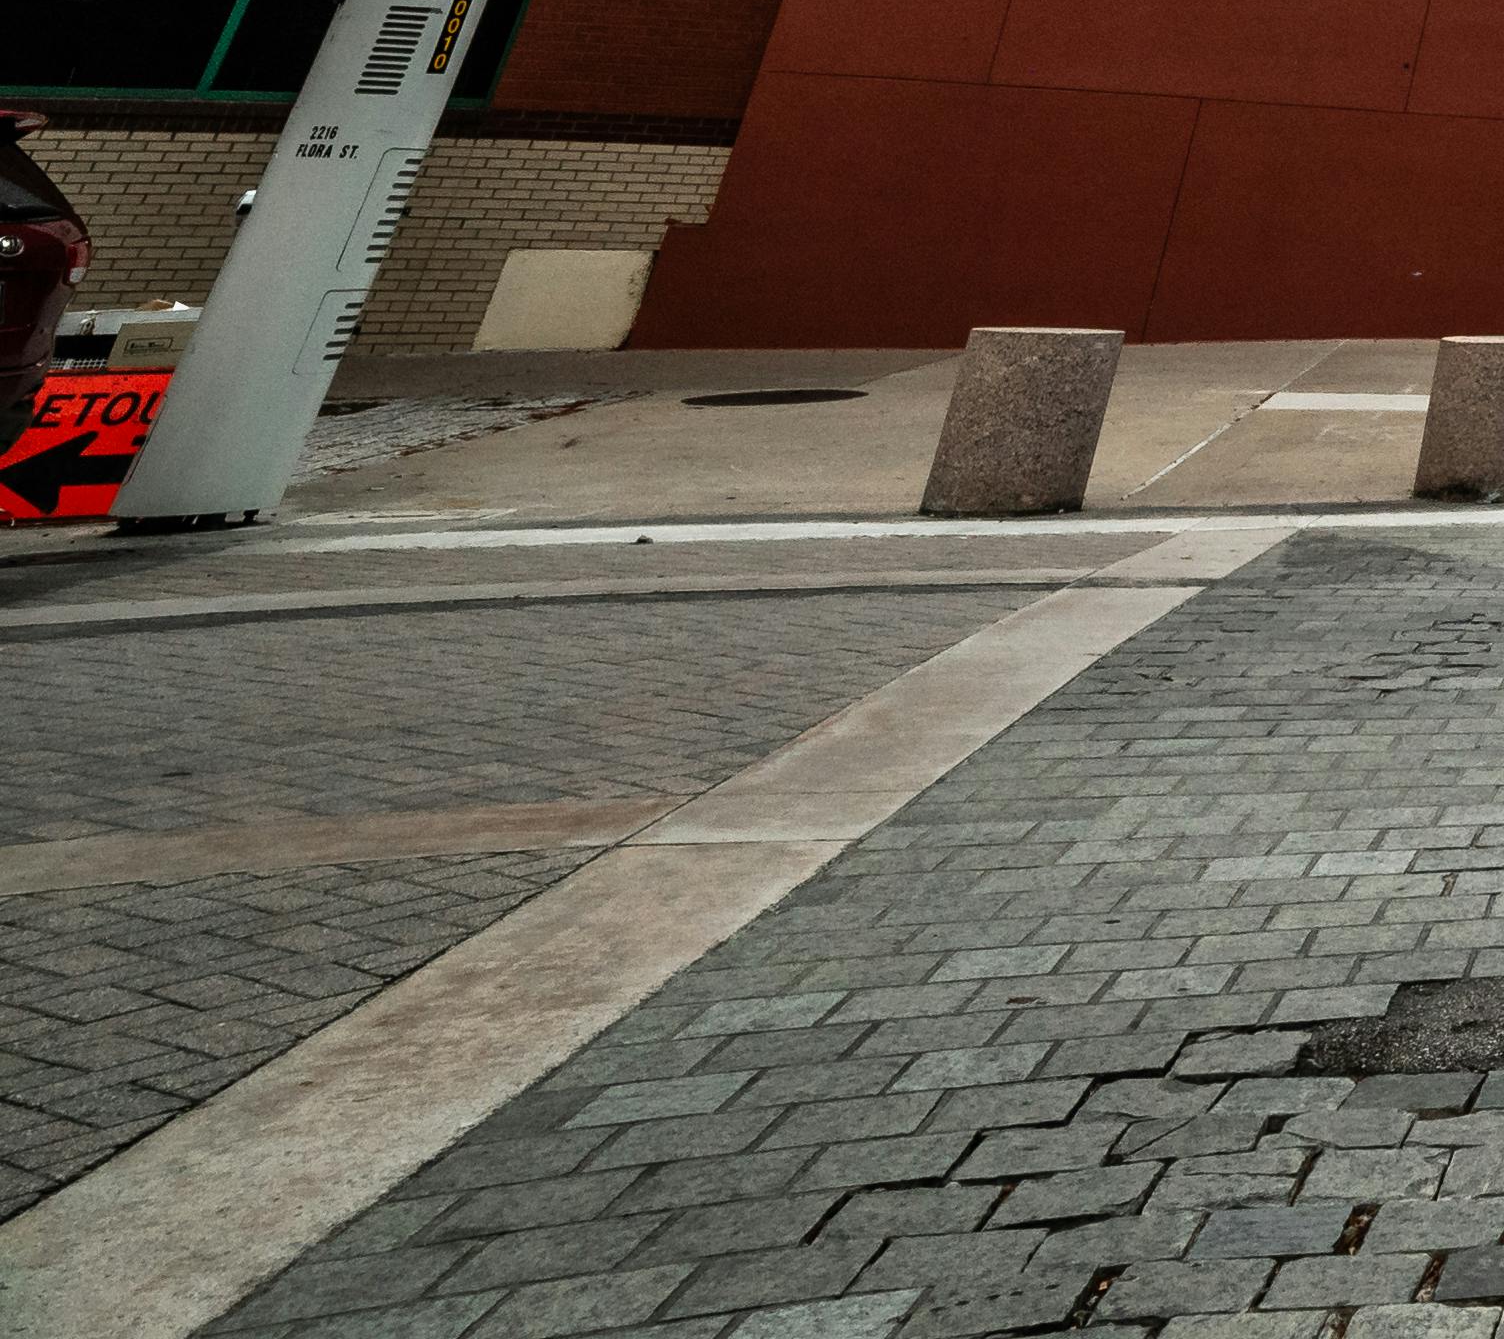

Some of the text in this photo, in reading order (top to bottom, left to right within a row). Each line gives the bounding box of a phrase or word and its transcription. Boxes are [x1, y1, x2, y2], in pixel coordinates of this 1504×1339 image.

[310, 126, 339, 140] 2216
[296, 144, 359, 159] FLORA ST.
